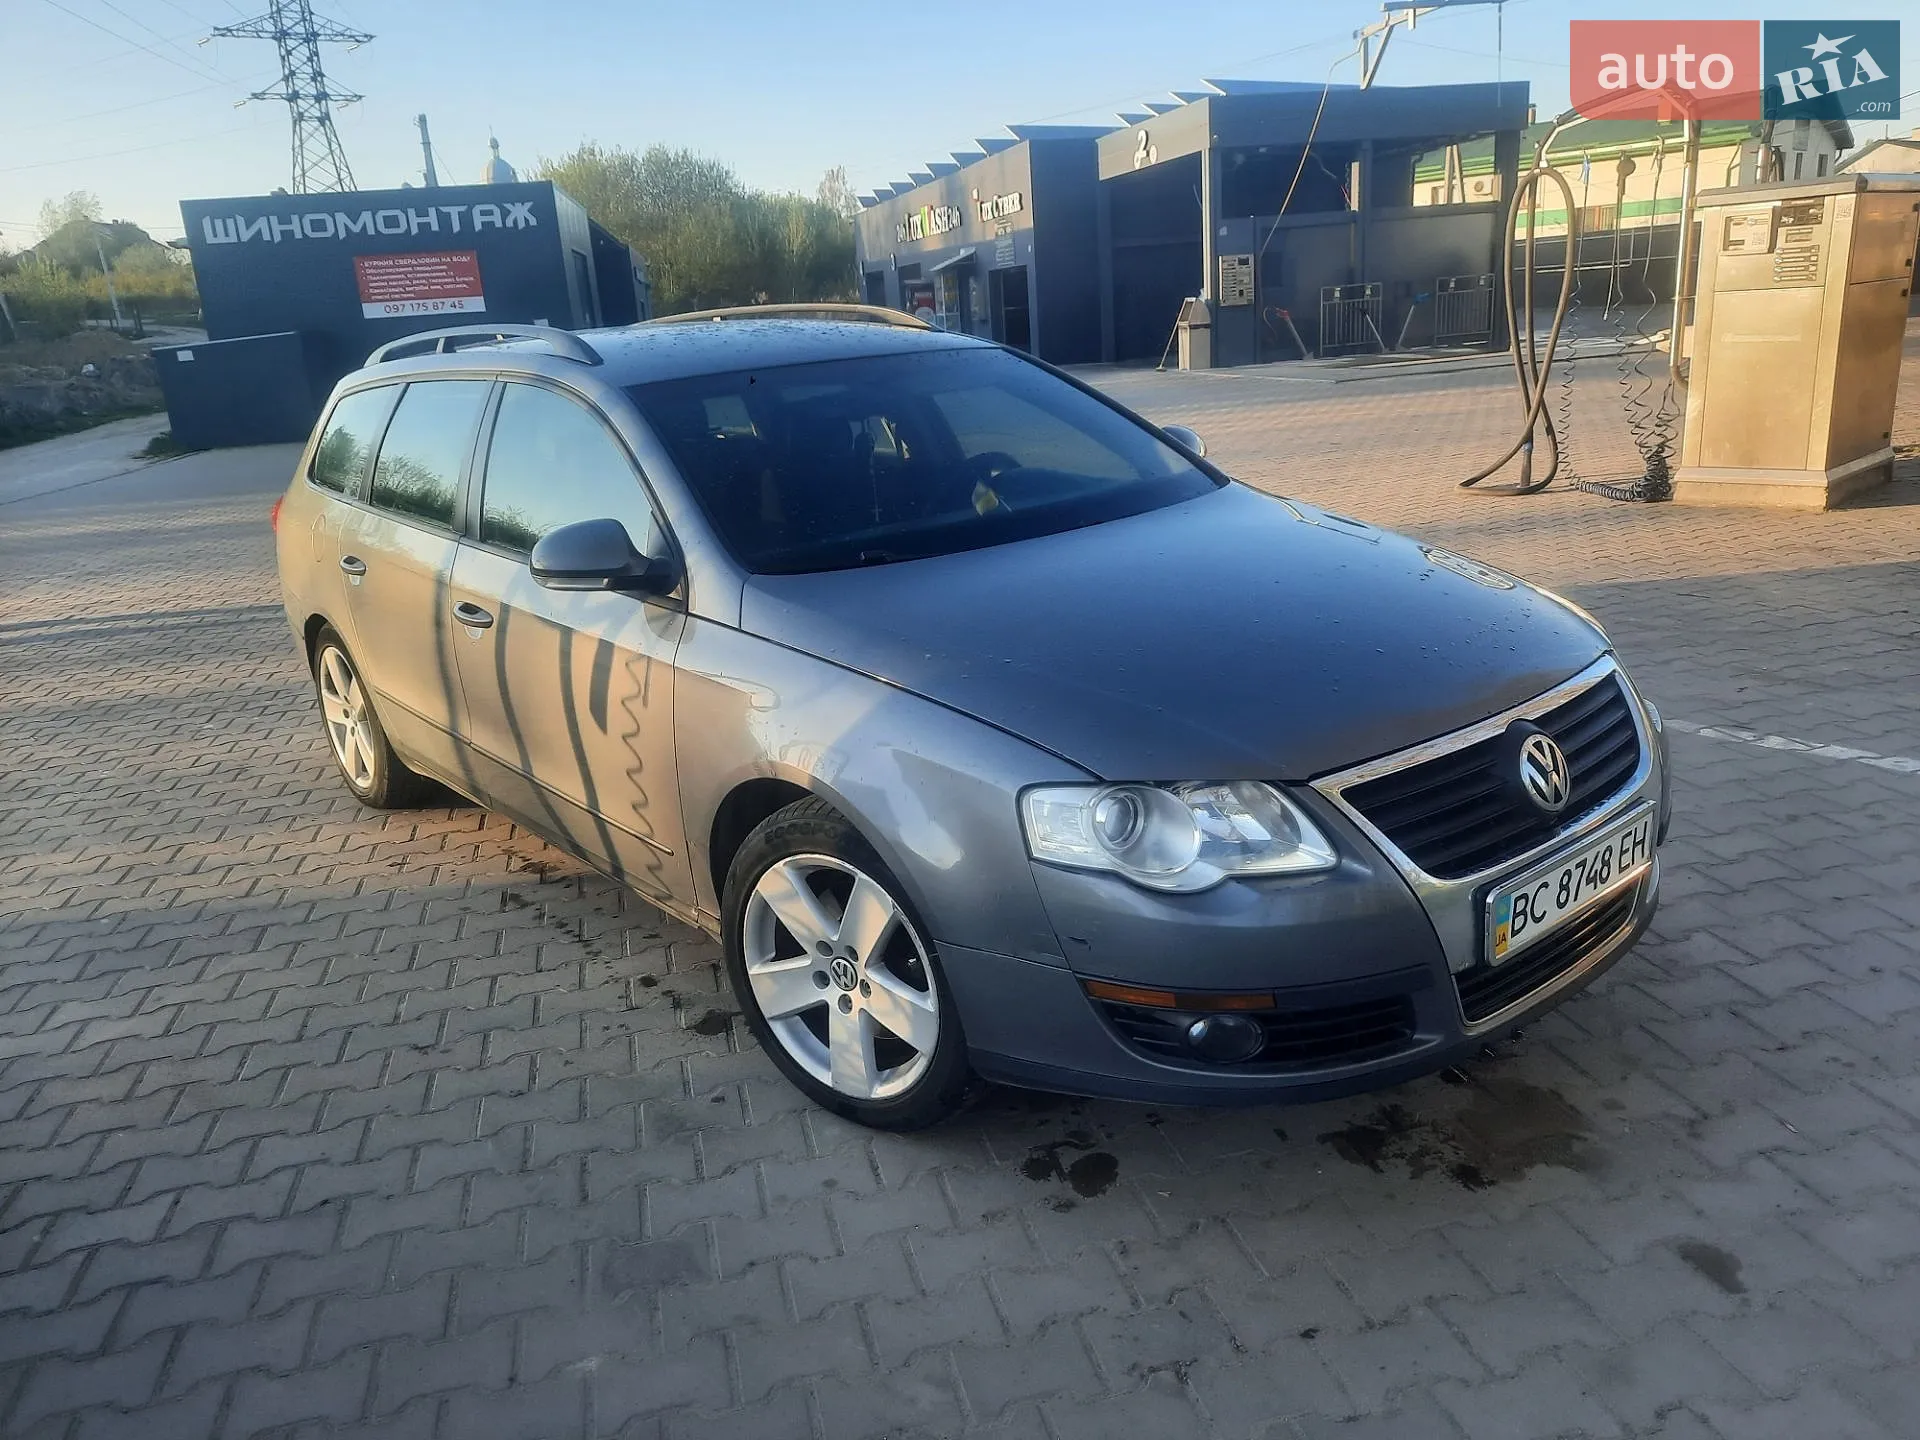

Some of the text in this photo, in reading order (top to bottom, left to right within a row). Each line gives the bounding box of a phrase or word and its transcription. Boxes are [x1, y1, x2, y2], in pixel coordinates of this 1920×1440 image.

[201, 201, 538, 245] ШИНОМОНТАЖ
[383, 300, 465, 314] 097 175 87 45
[1510, 820, 1649, 939] BC 8748 EH
